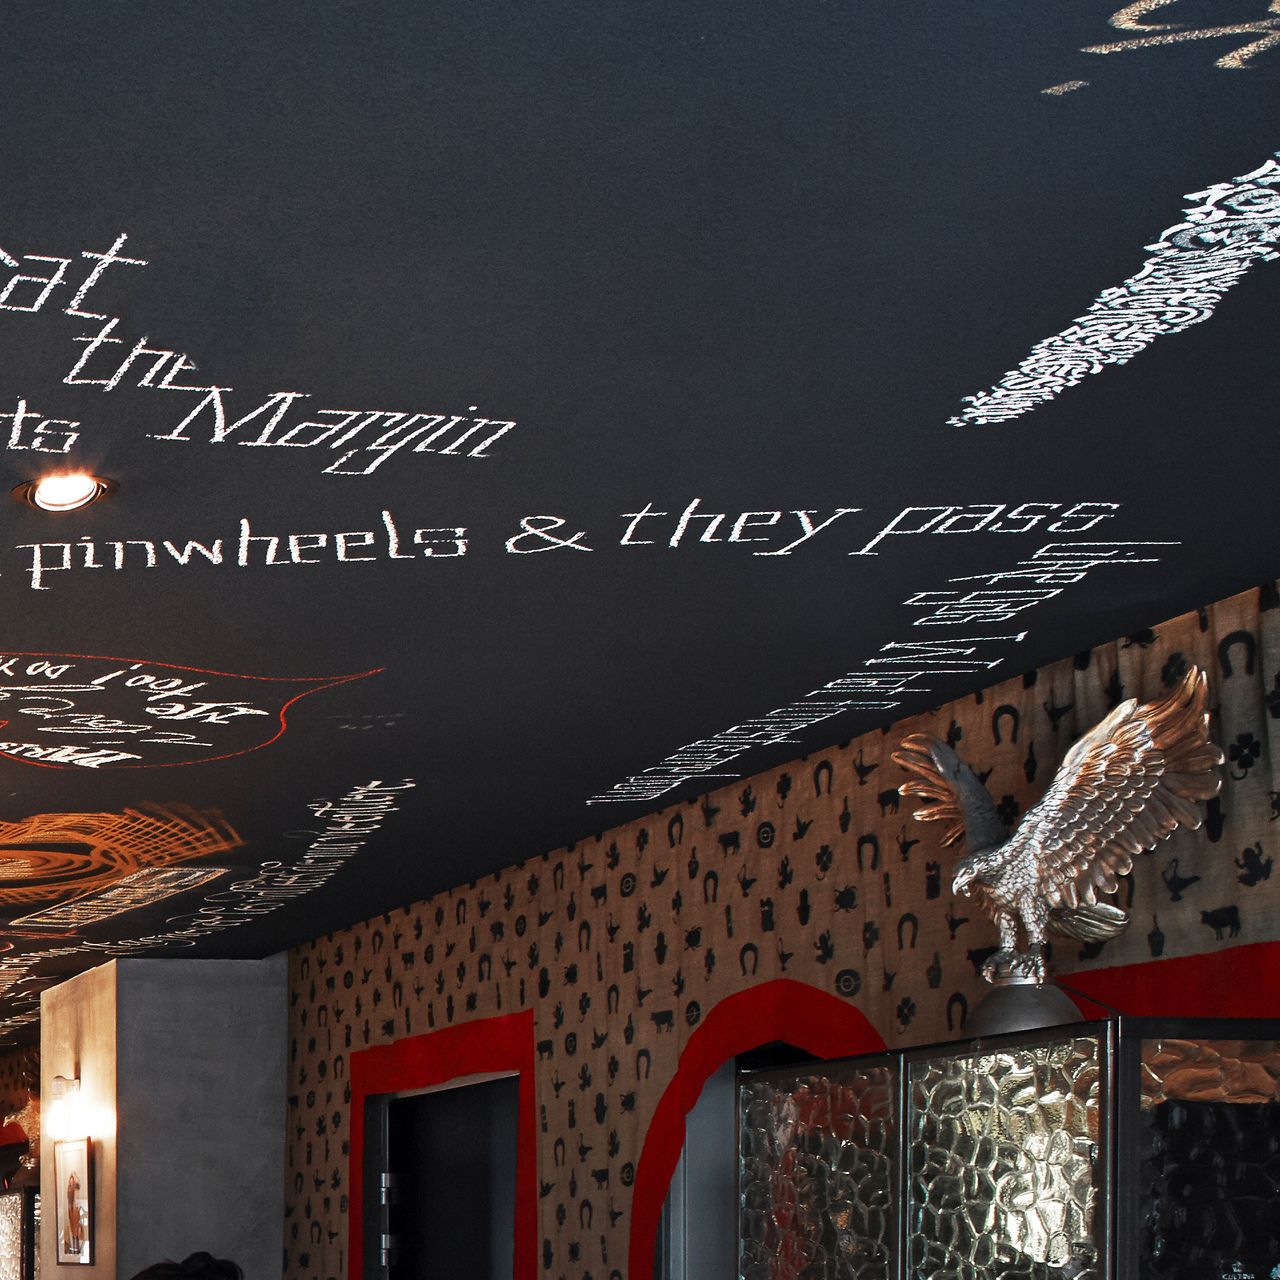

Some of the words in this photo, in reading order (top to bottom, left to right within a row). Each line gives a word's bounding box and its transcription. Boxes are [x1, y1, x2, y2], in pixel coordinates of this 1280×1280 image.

[64, 318, 230, 394] the
[147, 382, 517, 477] Margin
[17, 508, 469, 592] pinwheels
[504, 513, 595, 555] &
[619, 498, 863, 556] they
[848, 501, 1121, 556] pass
[902, 588, 1064, 626] gas
